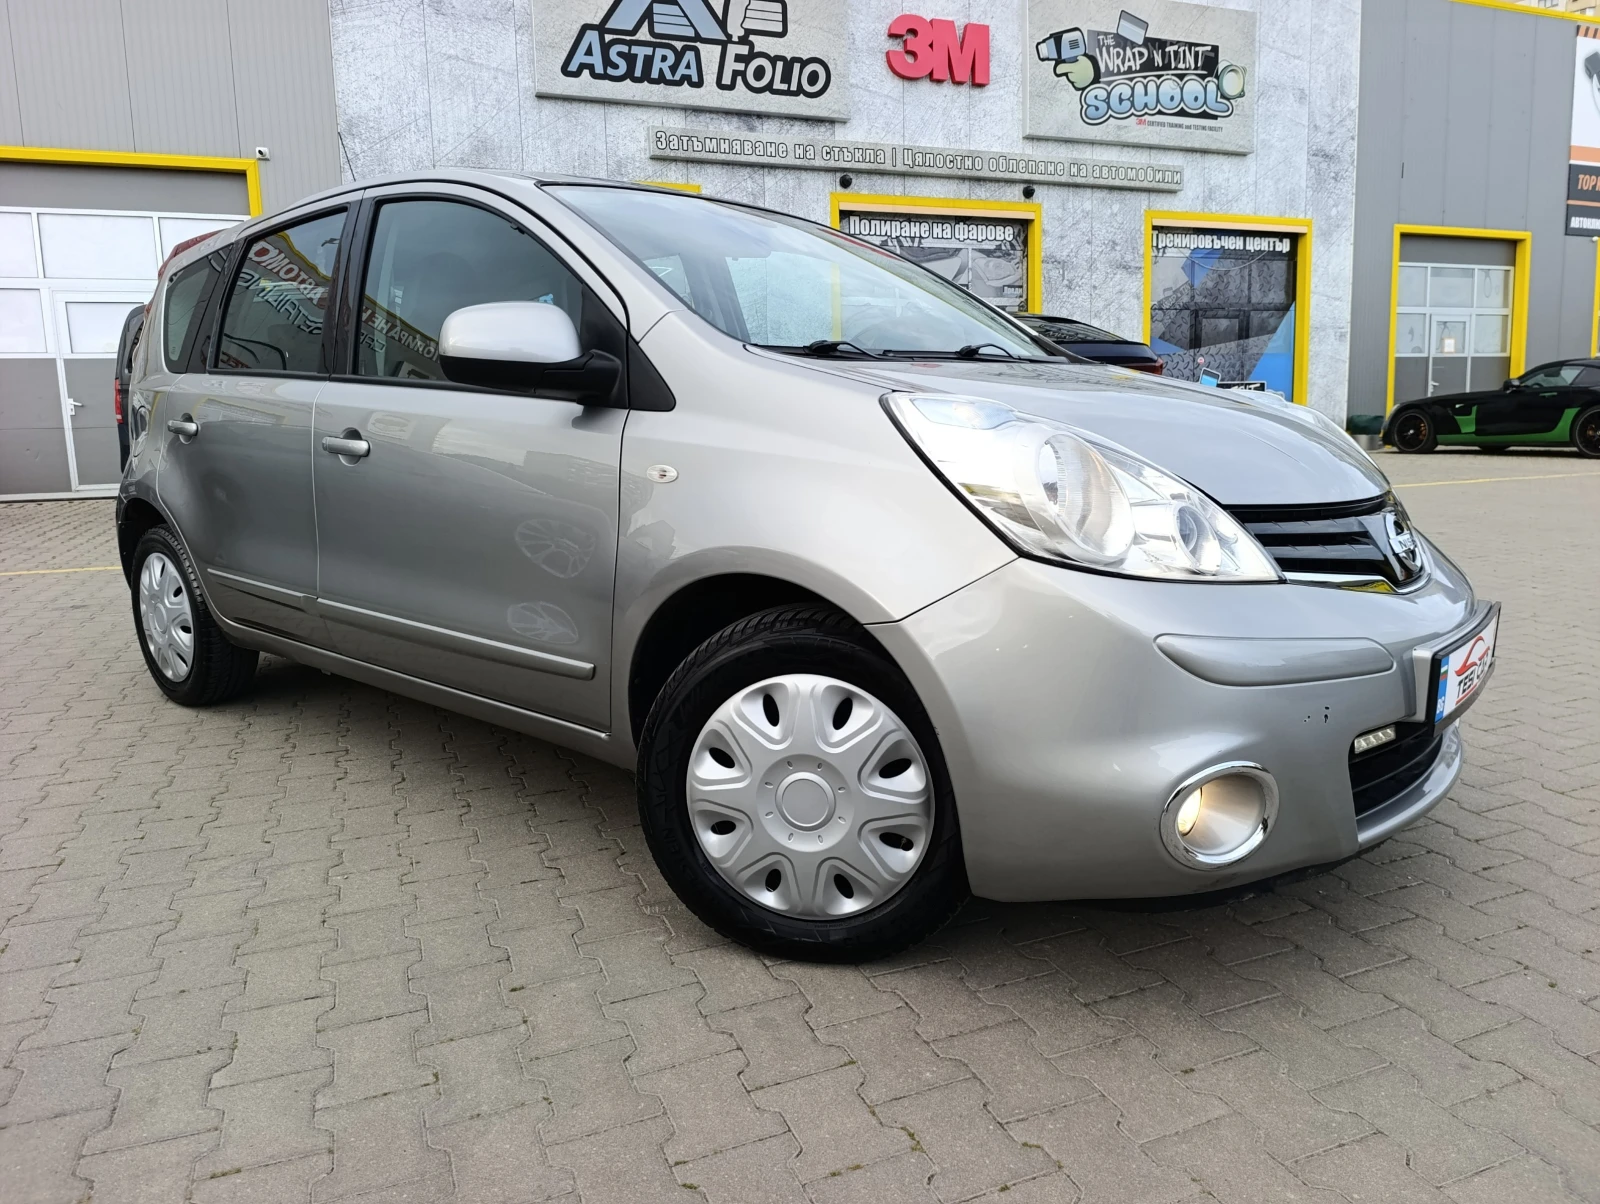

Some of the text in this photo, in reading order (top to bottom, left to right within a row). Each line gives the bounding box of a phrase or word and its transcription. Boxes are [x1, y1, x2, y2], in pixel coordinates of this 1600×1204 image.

[886, 13, 990, 87] 3M
[1098, 34, 1115, 46] THE
[566, 29, 827, 94] ASTRA FOLIO
[1096, 46, 1149, 74] WRAP
[1165, 45, 1212, 70] TINT
[1082, 76, 1232, 123] SCHOOL
[1136, 118, 1146, 127] 3M
[1147, 120, 1166, 128] CERTIFIED
[1207, 125, 1223, 133] FACILITY
[655, 130, 788, 158] Затъмняване
[794, 144, 815, 160] на
[822, 145, 886, 165] стъкла
[902, 148, 983, 172] Цялостно
[988, 157, 1065, 176] облепяне
[1070, 163, 1088, 178] на
[1092, 166, 1182, 185] автомобили
[849, 216, 1014, 242] Полиране на фарове
[1152, 230, 1290, 253] Тренировъчен център
